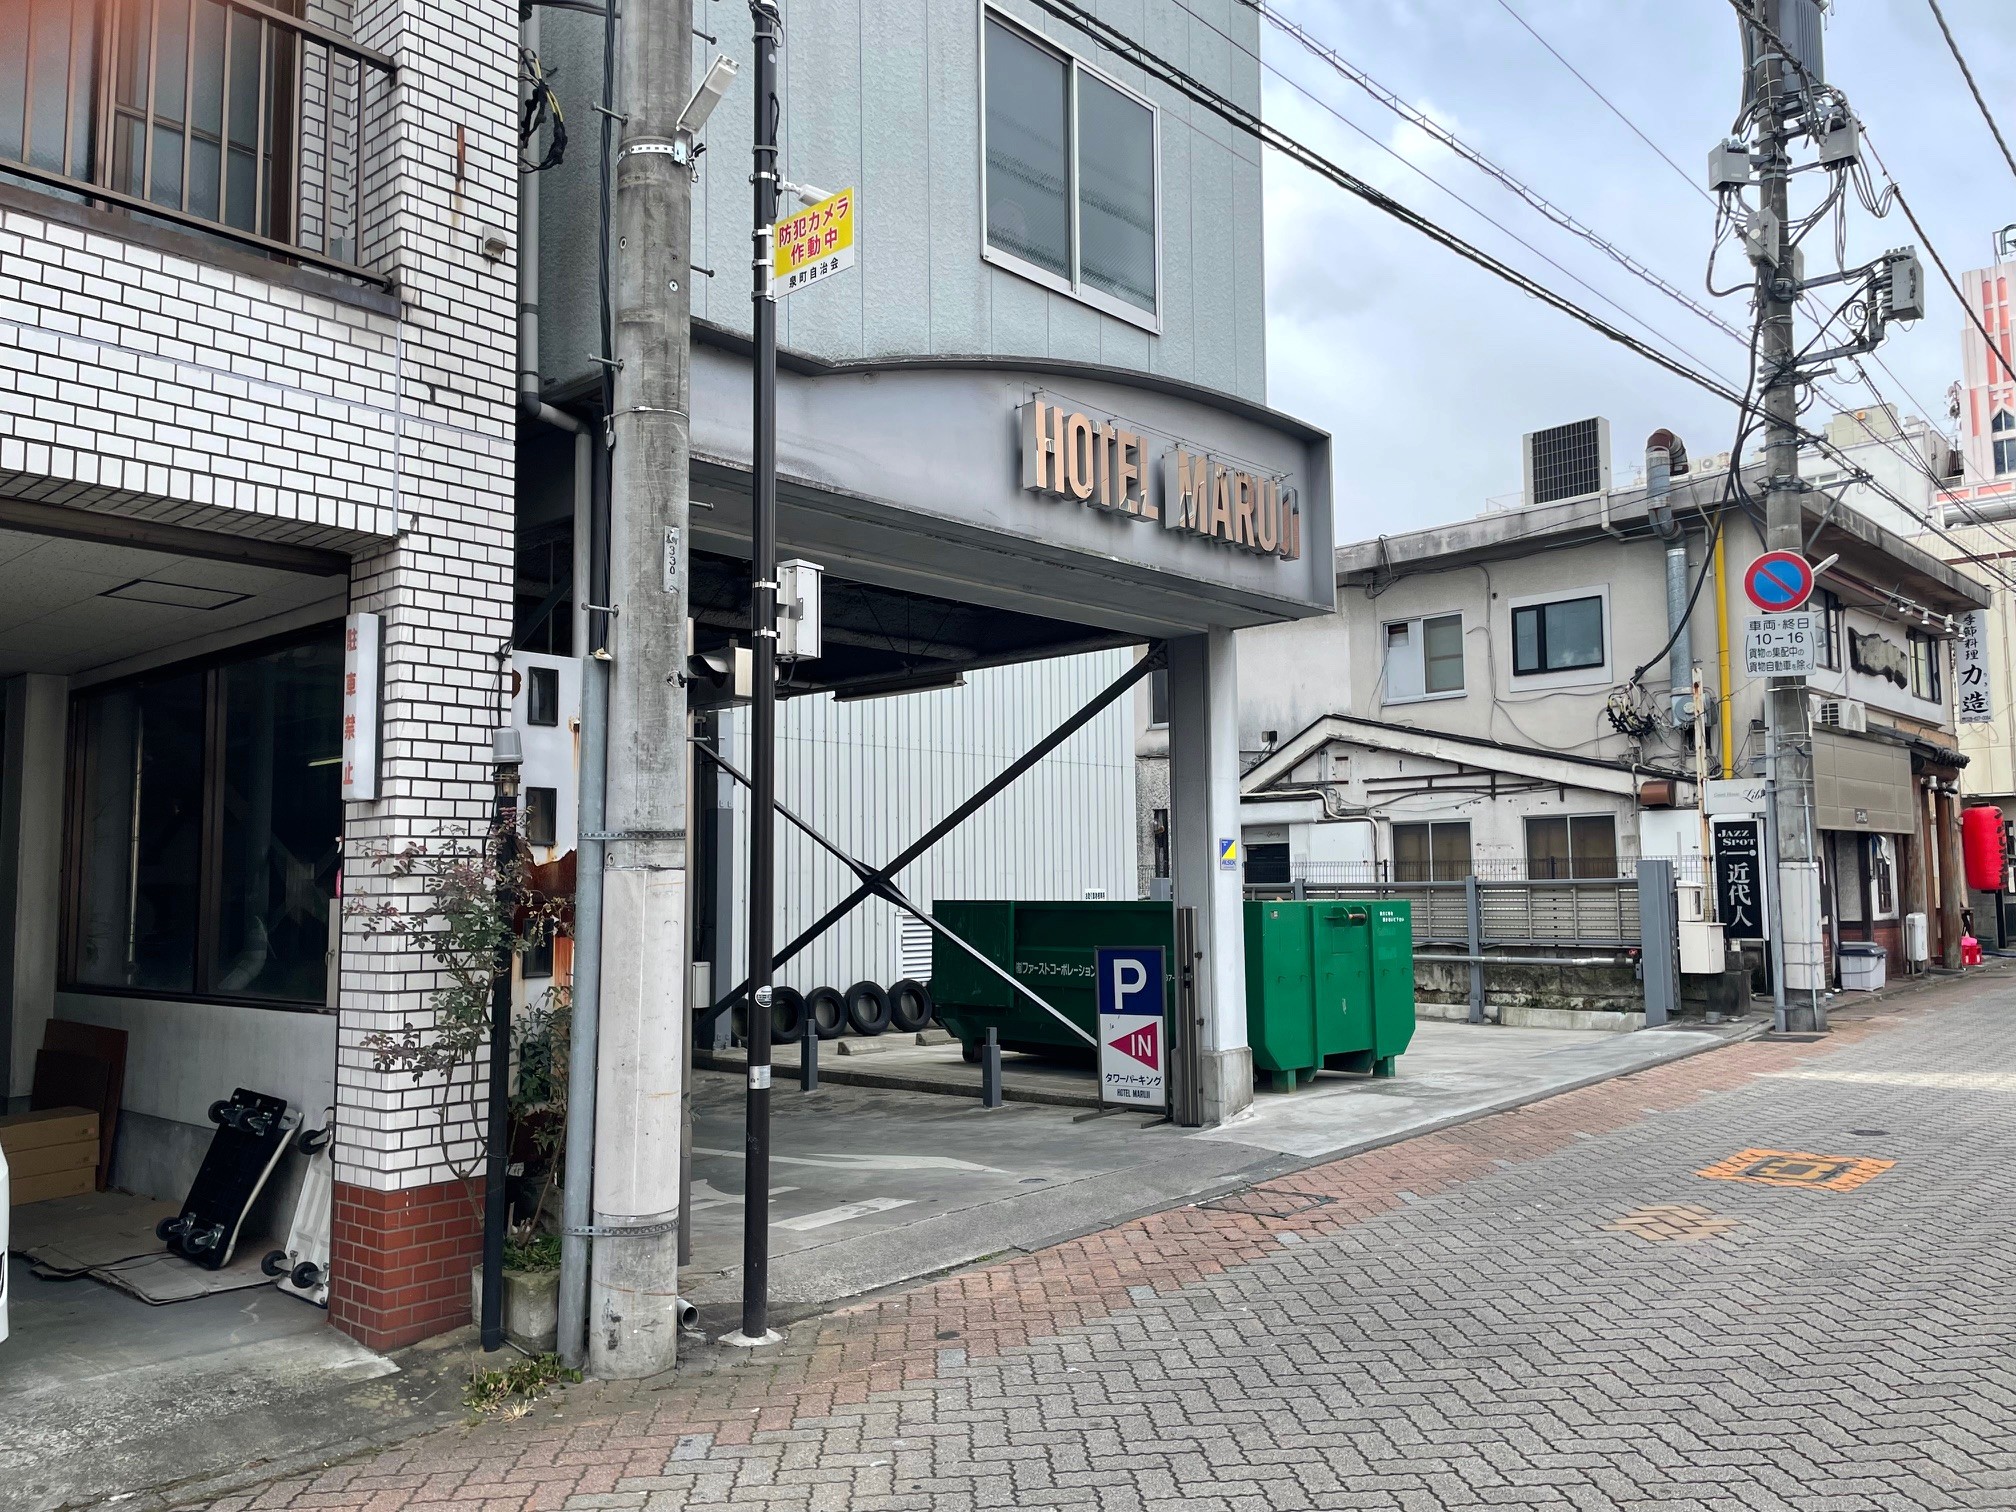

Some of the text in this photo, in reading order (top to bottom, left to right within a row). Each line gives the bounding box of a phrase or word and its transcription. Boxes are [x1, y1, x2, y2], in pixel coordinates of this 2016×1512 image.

[779, 196, 849, 247] 防犯カメラ
[791, 227, 838, 265] 作動中
[789, 257, 839, 288] 泉町自治会
[1023, 400, 1158, 522] HOTEL
[1749, 647, 1804, 659] 貨物の集配中の
[1963, 613, 1979, 661] 季節料理
[1749, 660, 1811, 673] 貨物自動車を除く
[343, 628, 357, 785] 駐車禁止
[1962, 664, 1988, 713] 力造
[1718, 829, 1750, 838] JAZZ
[1723, 838, 1756, 847] SPOT
[1727, 862, 1753, 928] 近代人
[1113, 958, 1147, 1010] P
[1131, 1034, 1152, 1057] IN
[1105, 1073, 1162, 1086] タワーパーキング
